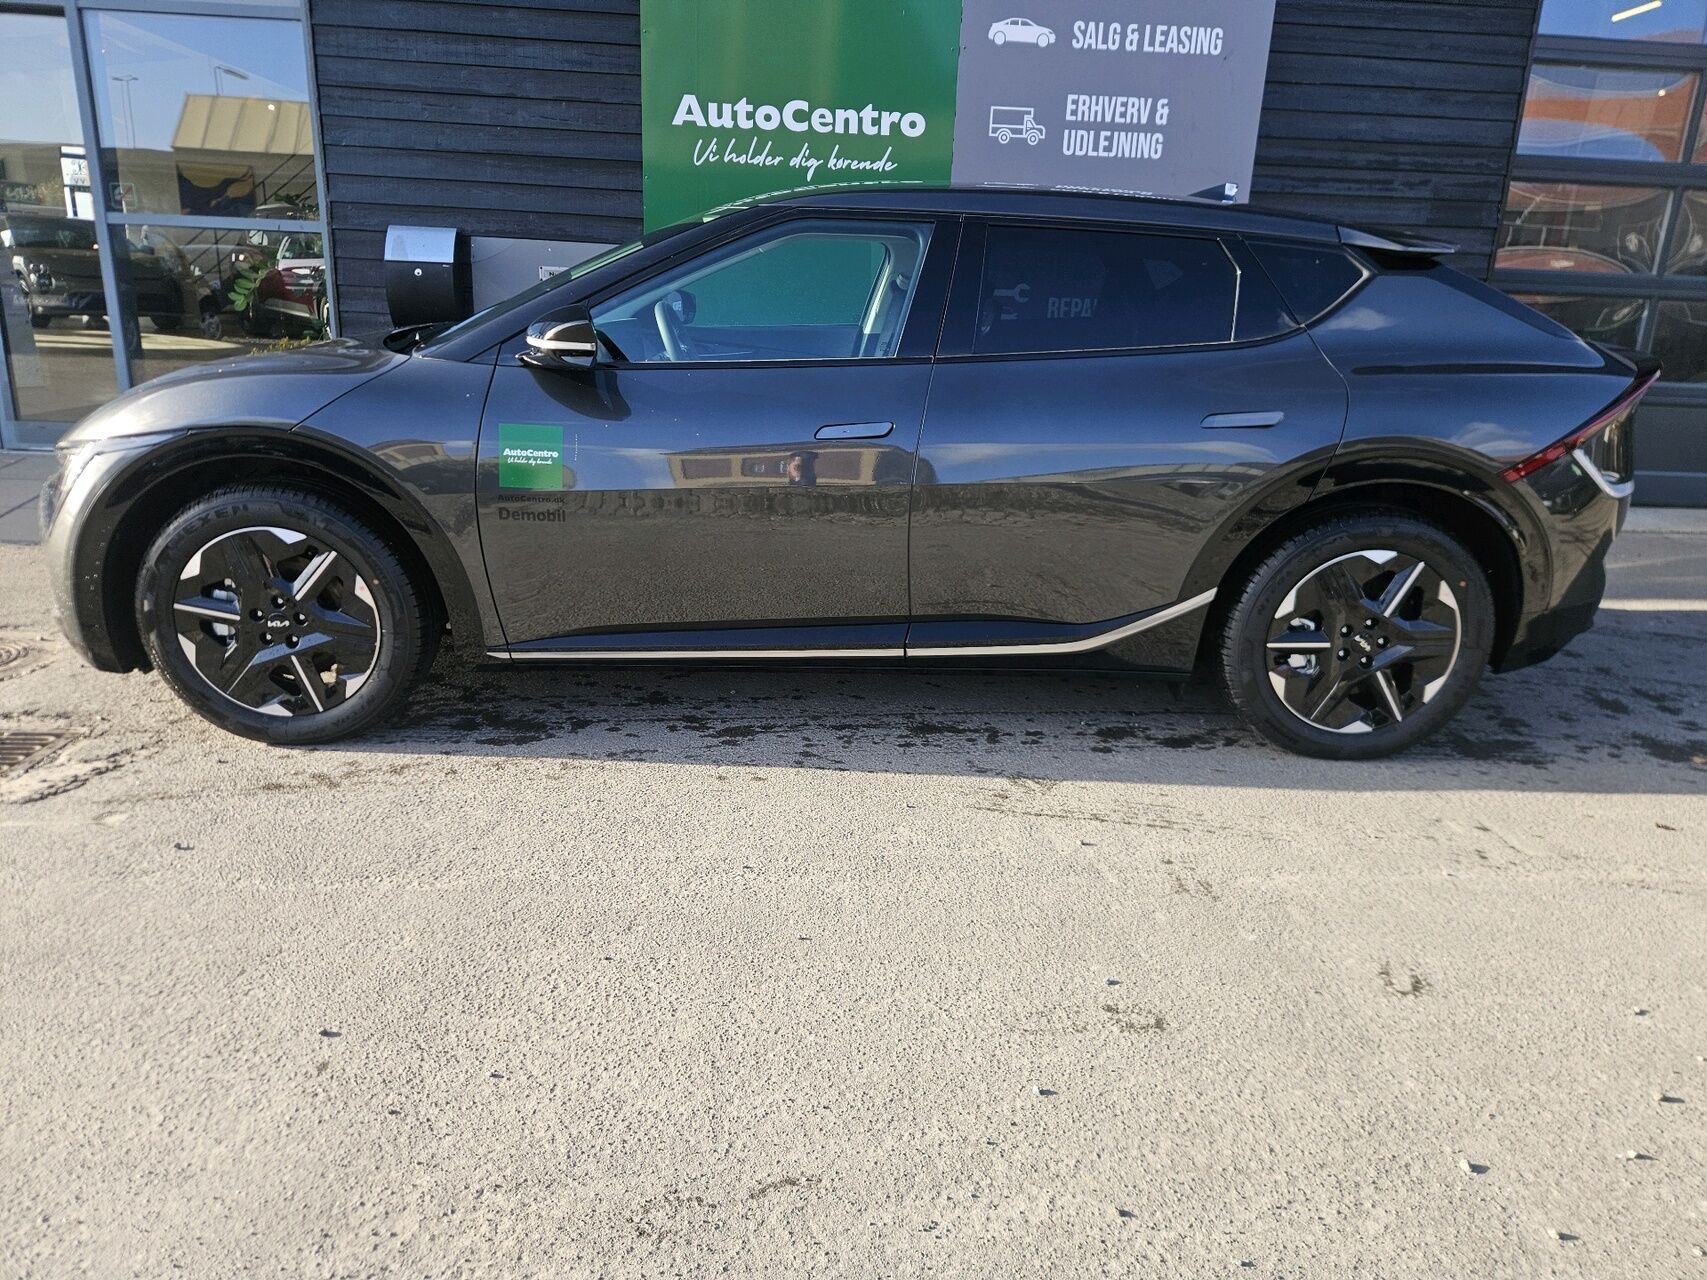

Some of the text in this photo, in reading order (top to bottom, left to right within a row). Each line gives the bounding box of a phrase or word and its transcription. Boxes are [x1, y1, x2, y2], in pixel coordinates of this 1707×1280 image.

[1071, 20, 1224, 56] SALG & LEASING
[671, 93, 927, 138] AutoCentro
[1065, 94, 1170, 126] ERHVERV &
[693, 136, 899, 182] Vi holder dig kørende
[1062, 129, 1164, 160] UDLEJNING
[503, 448, 559, 458] AutoCentro
[498, 507, 566, 522] Demobil
